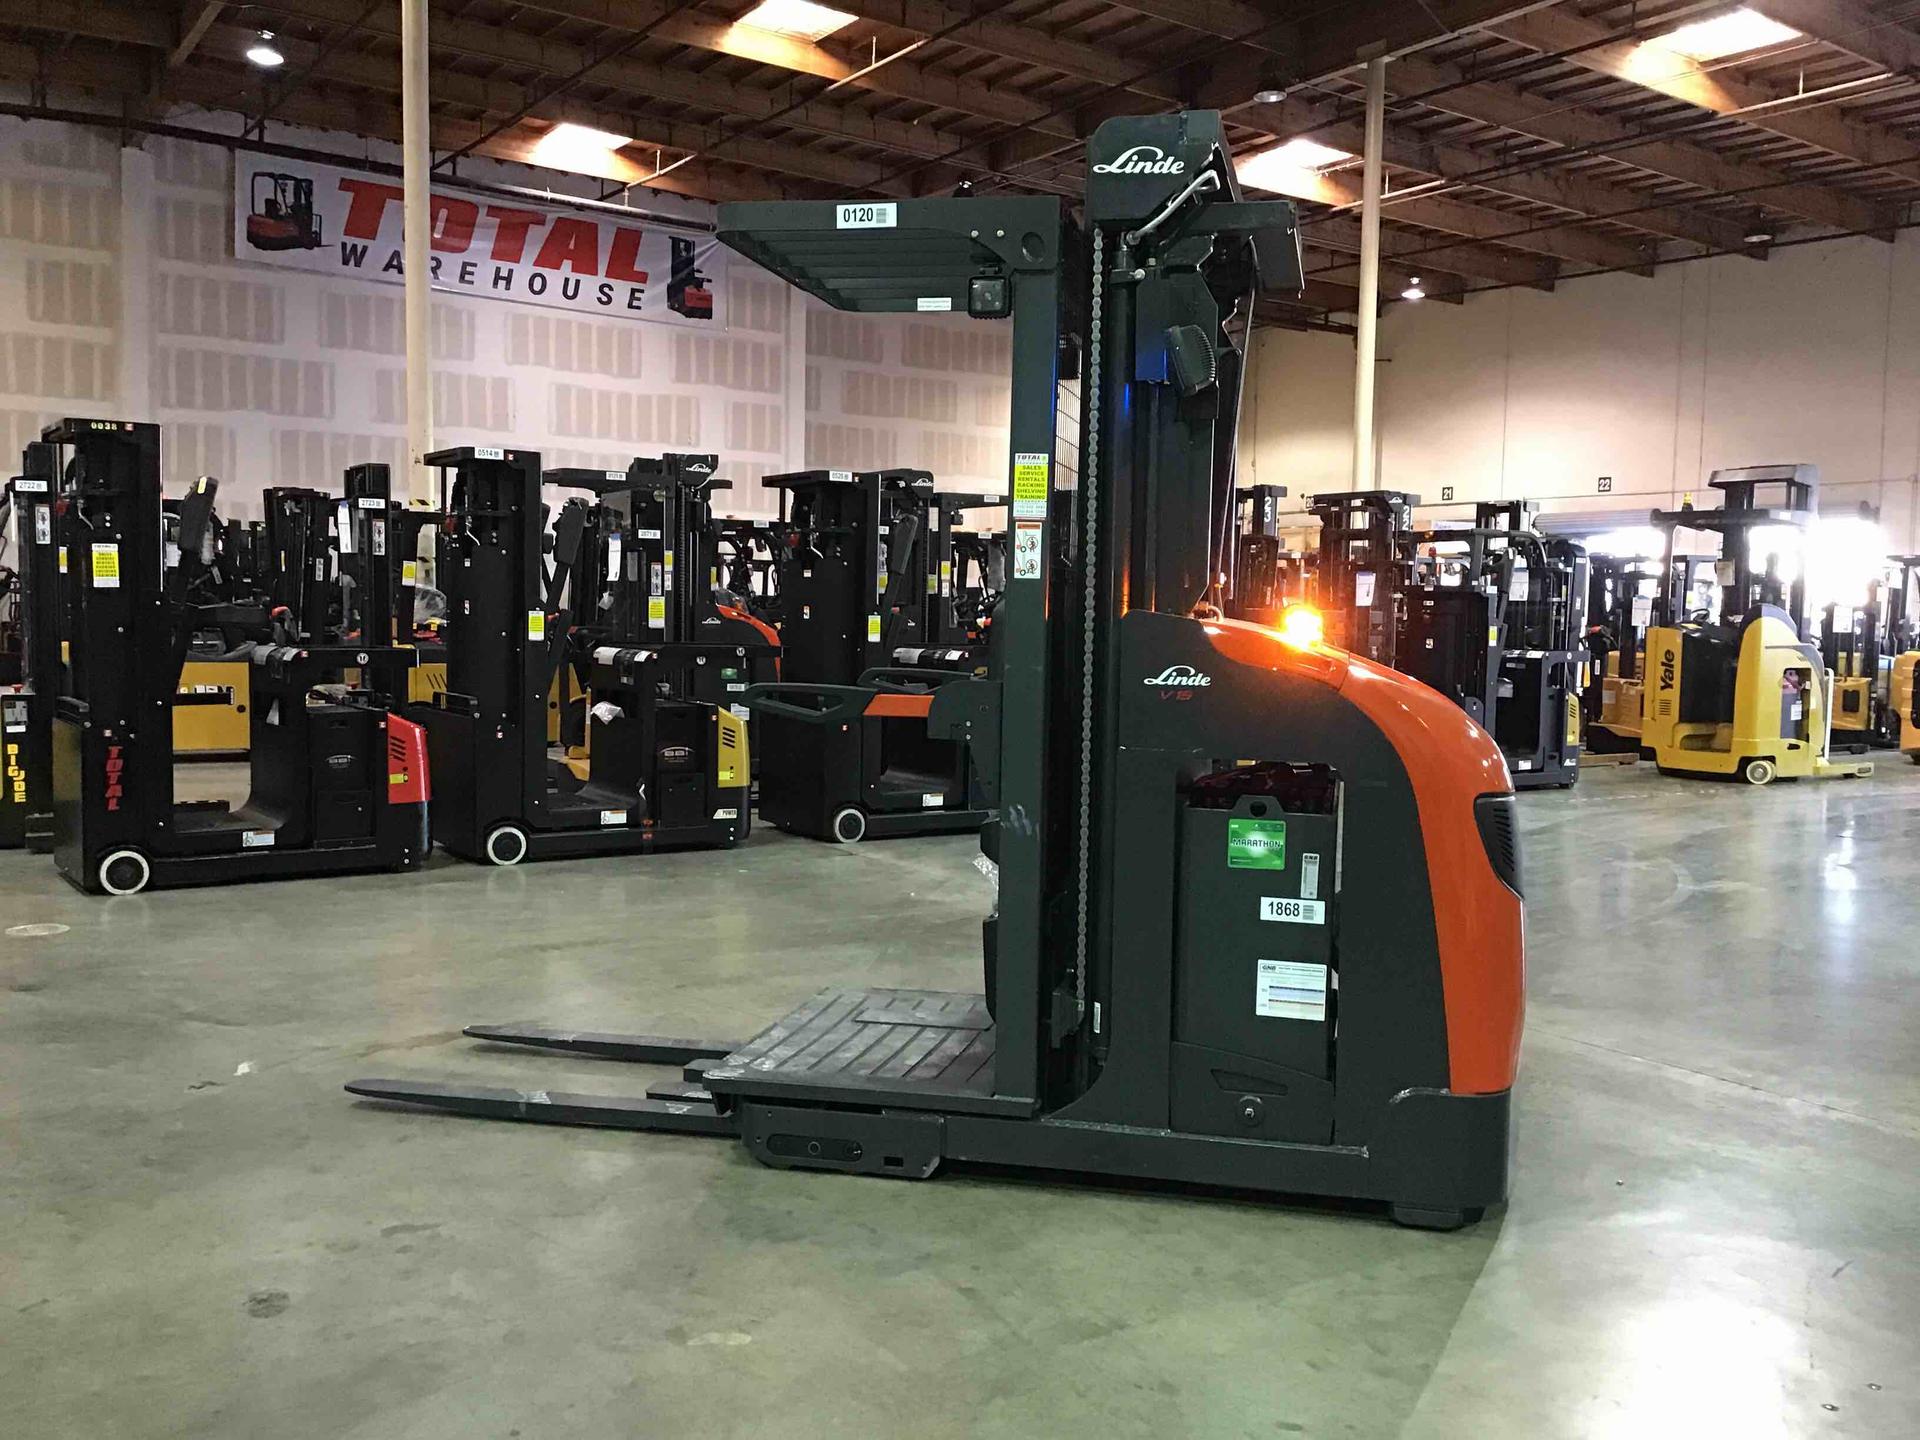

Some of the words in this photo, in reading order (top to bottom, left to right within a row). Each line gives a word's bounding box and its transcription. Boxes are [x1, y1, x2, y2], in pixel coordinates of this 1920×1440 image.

[1093, 146, 1184, 174] Linde
[843, 207, 874, 222] 0120
[337, 177, 649, 284] TOTAL
[341, 242, 645, 310] WAREHOUSE
[91, 422, 117, 430] 0038
[478, 449, 493, 457] 0514
[1443, 488, 1452, 500] 21
[1599, 479, 1610, 491] 22
[1263, 496, 1272, 523] 23
[1402, 505, 1410, 531] 22
[1143, 665, 1211, 686] Linde
[1660, 649, 1675, 691] Yale
[106, 747, 123, 811] TOTAL
[1232, 838, 1281, 848] MARATHON
[1267, 901, 1301, 917] 1868
